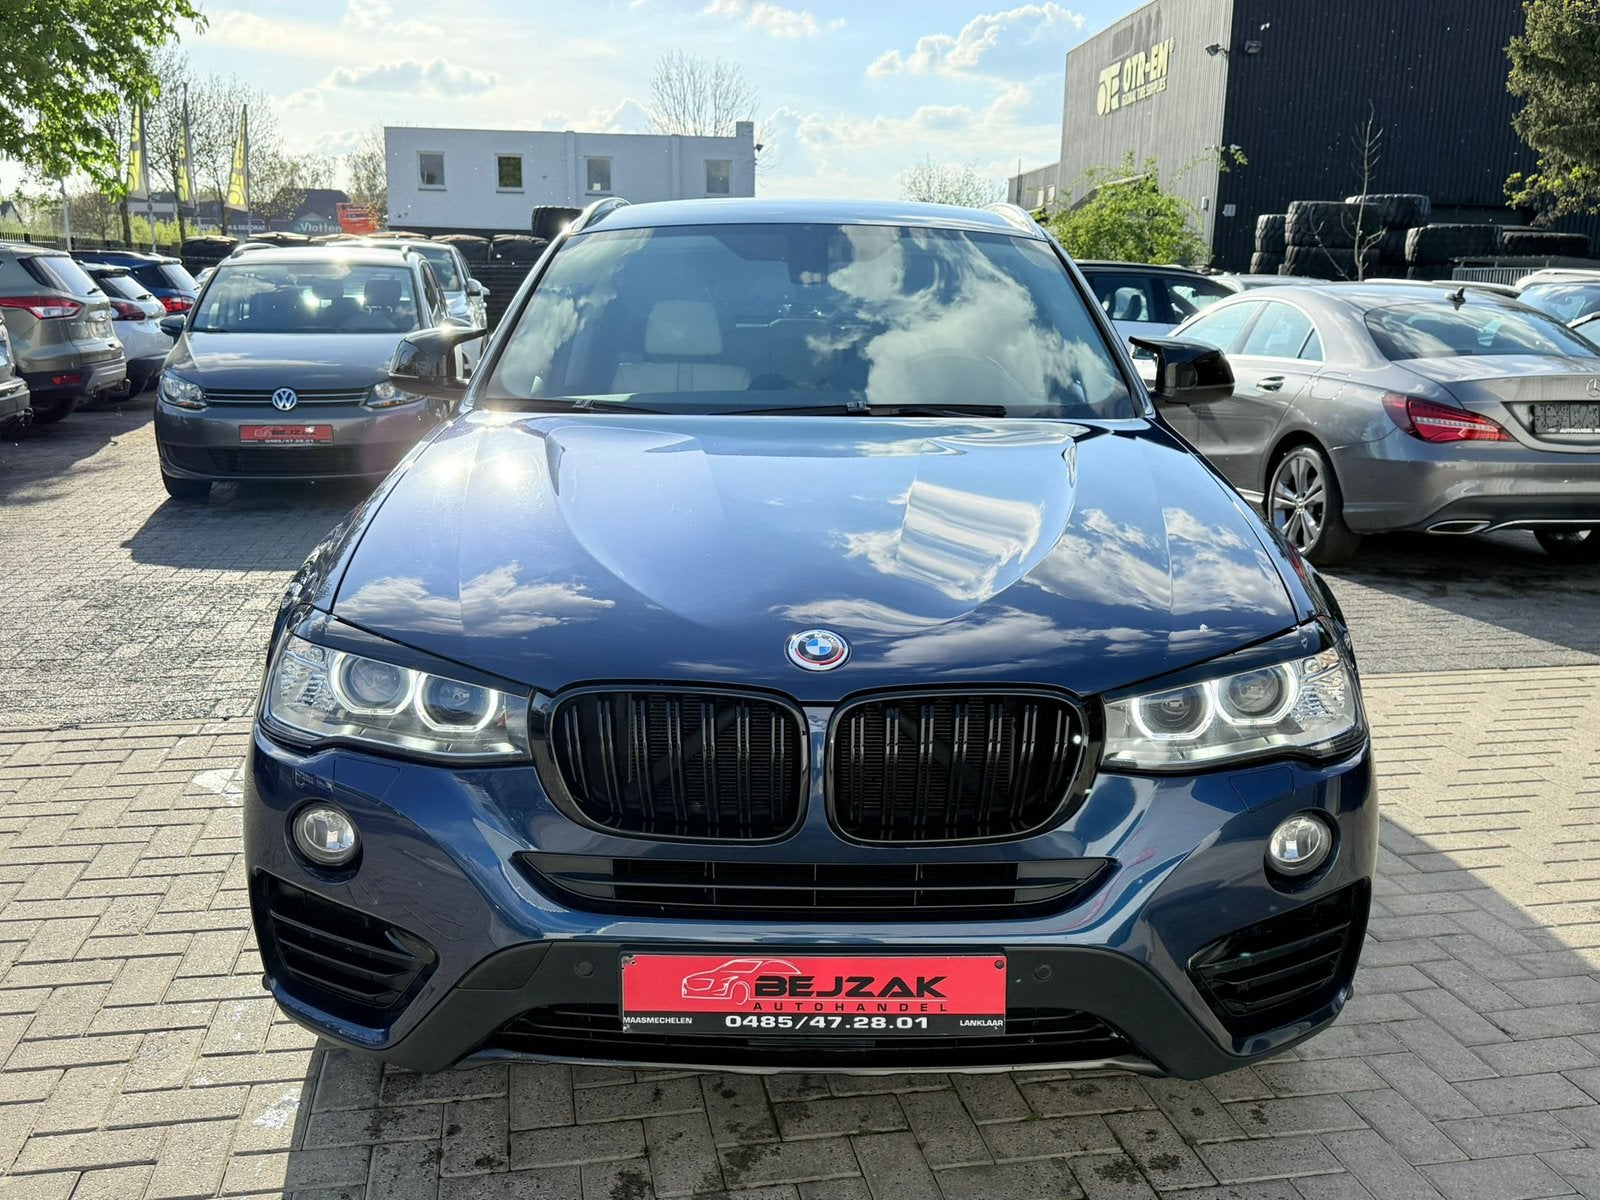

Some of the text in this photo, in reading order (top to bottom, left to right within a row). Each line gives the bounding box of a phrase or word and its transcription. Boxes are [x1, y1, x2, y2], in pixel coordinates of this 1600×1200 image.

[755, 975, 948, 998] BEJZAK
[753, 1002, 947, 1012] AUTOHANDEL
[623, 1016, 693, 1024] MAASMECHELEN
[724, 1015, 928, 1029] 0485/47.28.01
[959, 1019, 1004, 1027] LANKLAAR
